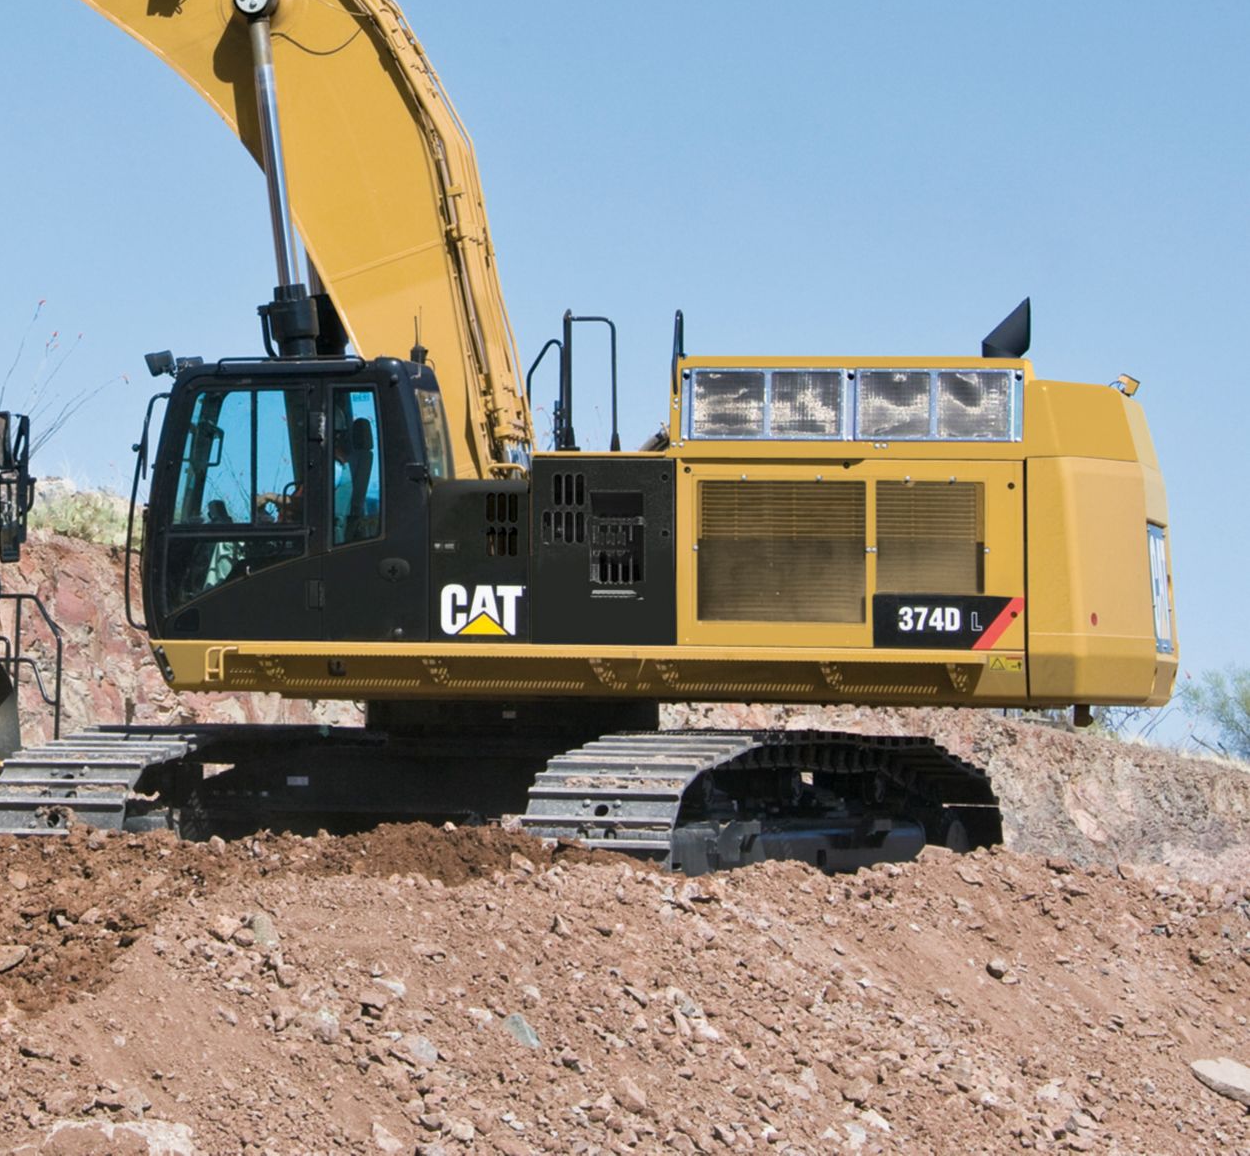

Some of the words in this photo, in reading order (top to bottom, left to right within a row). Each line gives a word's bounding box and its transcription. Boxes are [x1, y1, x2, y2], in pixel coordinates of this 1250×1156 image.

[441, 584, 523, 635] CAT
[898, 606, 961, 632] 374D
[971, 612, 983, 632] L
